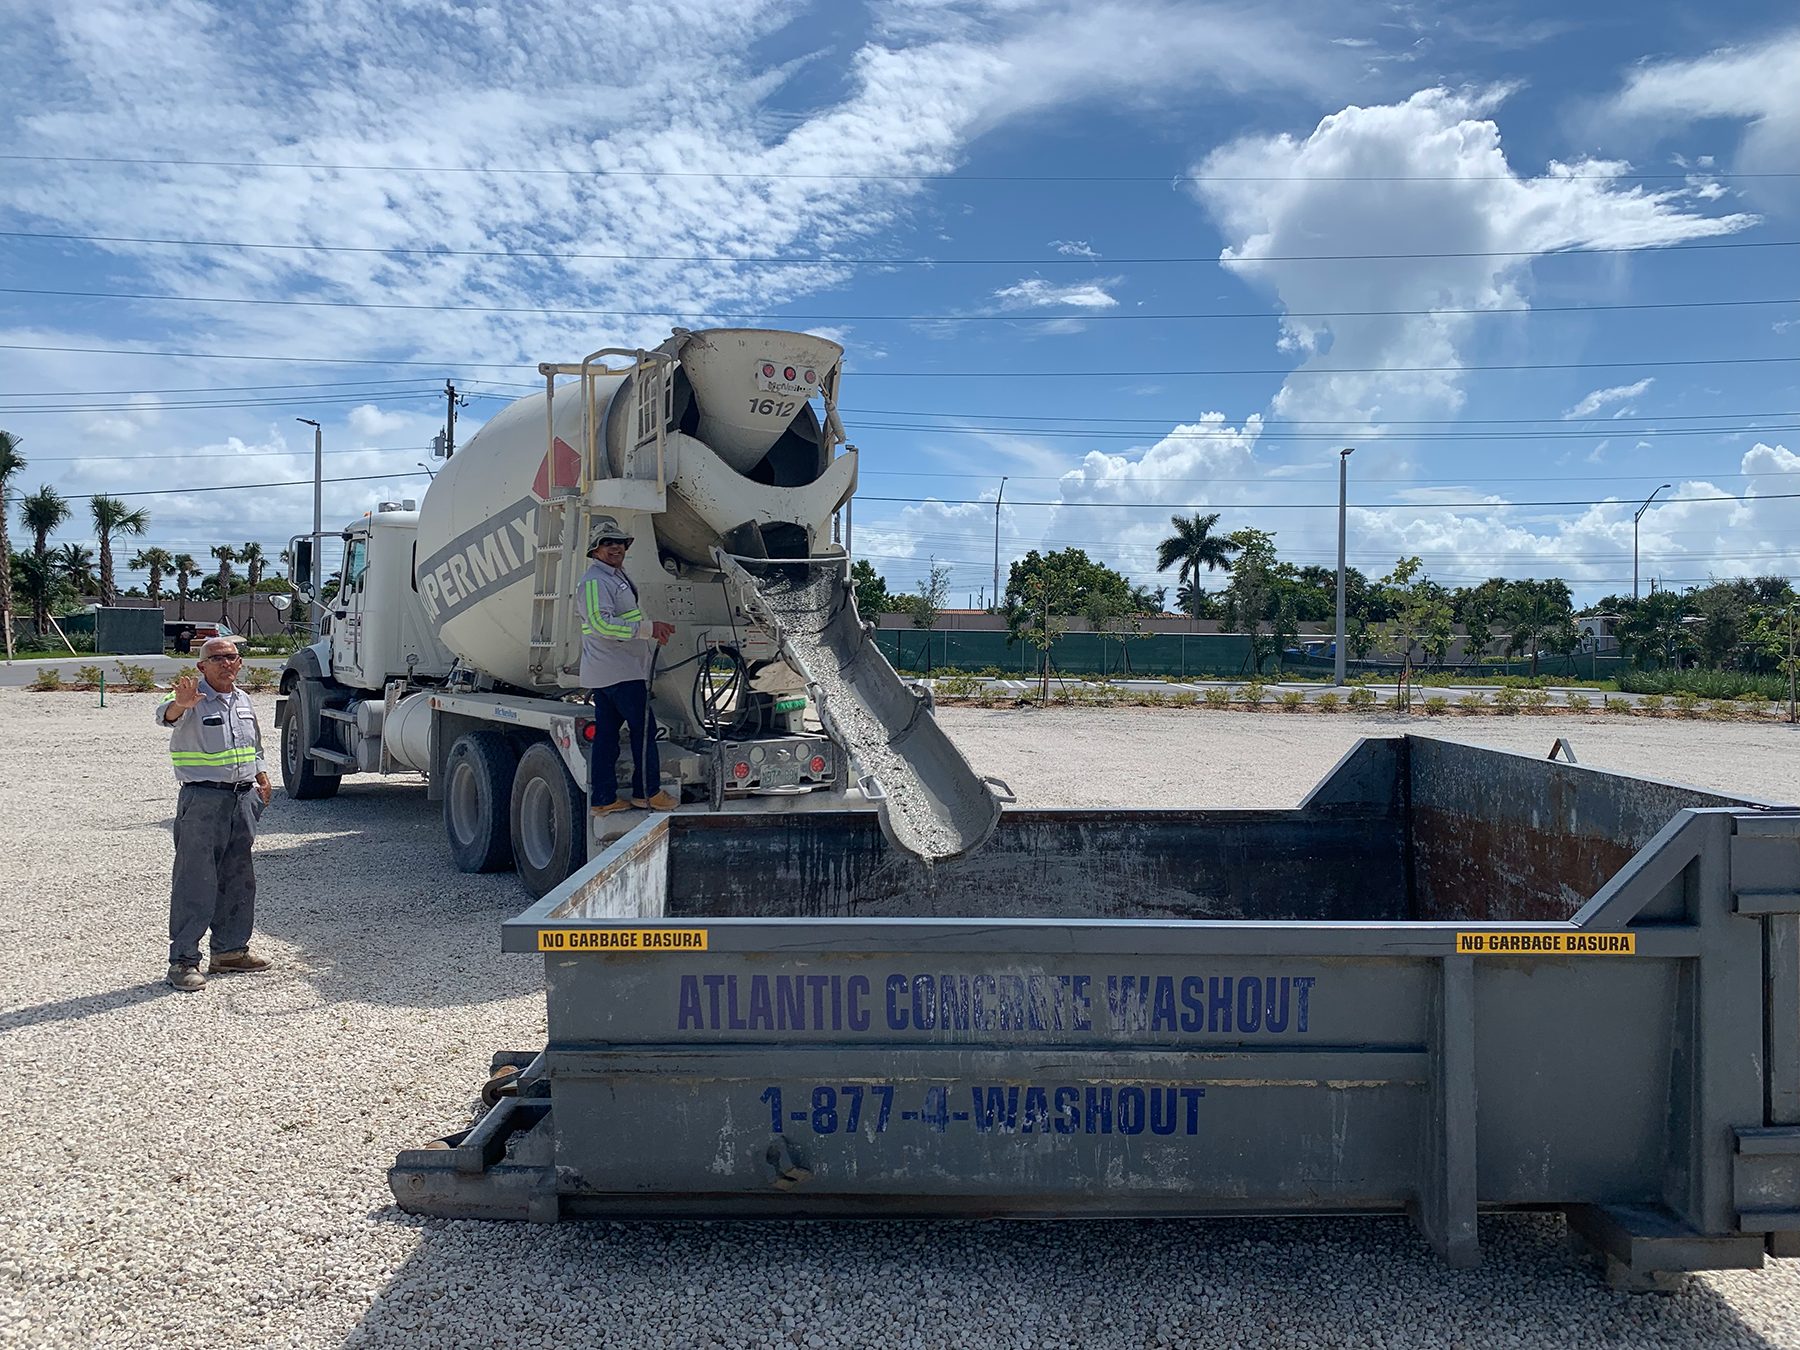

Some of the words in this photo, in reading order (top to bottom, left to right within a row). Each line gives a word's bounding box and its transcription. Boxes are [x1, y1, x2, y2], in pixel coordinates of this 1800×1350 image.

[749, 398, 796, 417] 1612
[543, 933, 564, 948] NO
[569, 932, 637, 948] GARBAGE
[643, 933, 703, 948] BASURA
[1461, 935, 1484, 951] NO
[1488, 935, 1561, 951] GARBAGE
[1566, 936, 1630, 951] BASURA
[677, 974, 871, 1031] ATLANTIC
[885, 973, 1092, 1032] CONCRETE
[1107, 974, 1316, 1034] WASHOUT
[759, 1085, 1206, 1136] 1-877-4-WASHOUT
